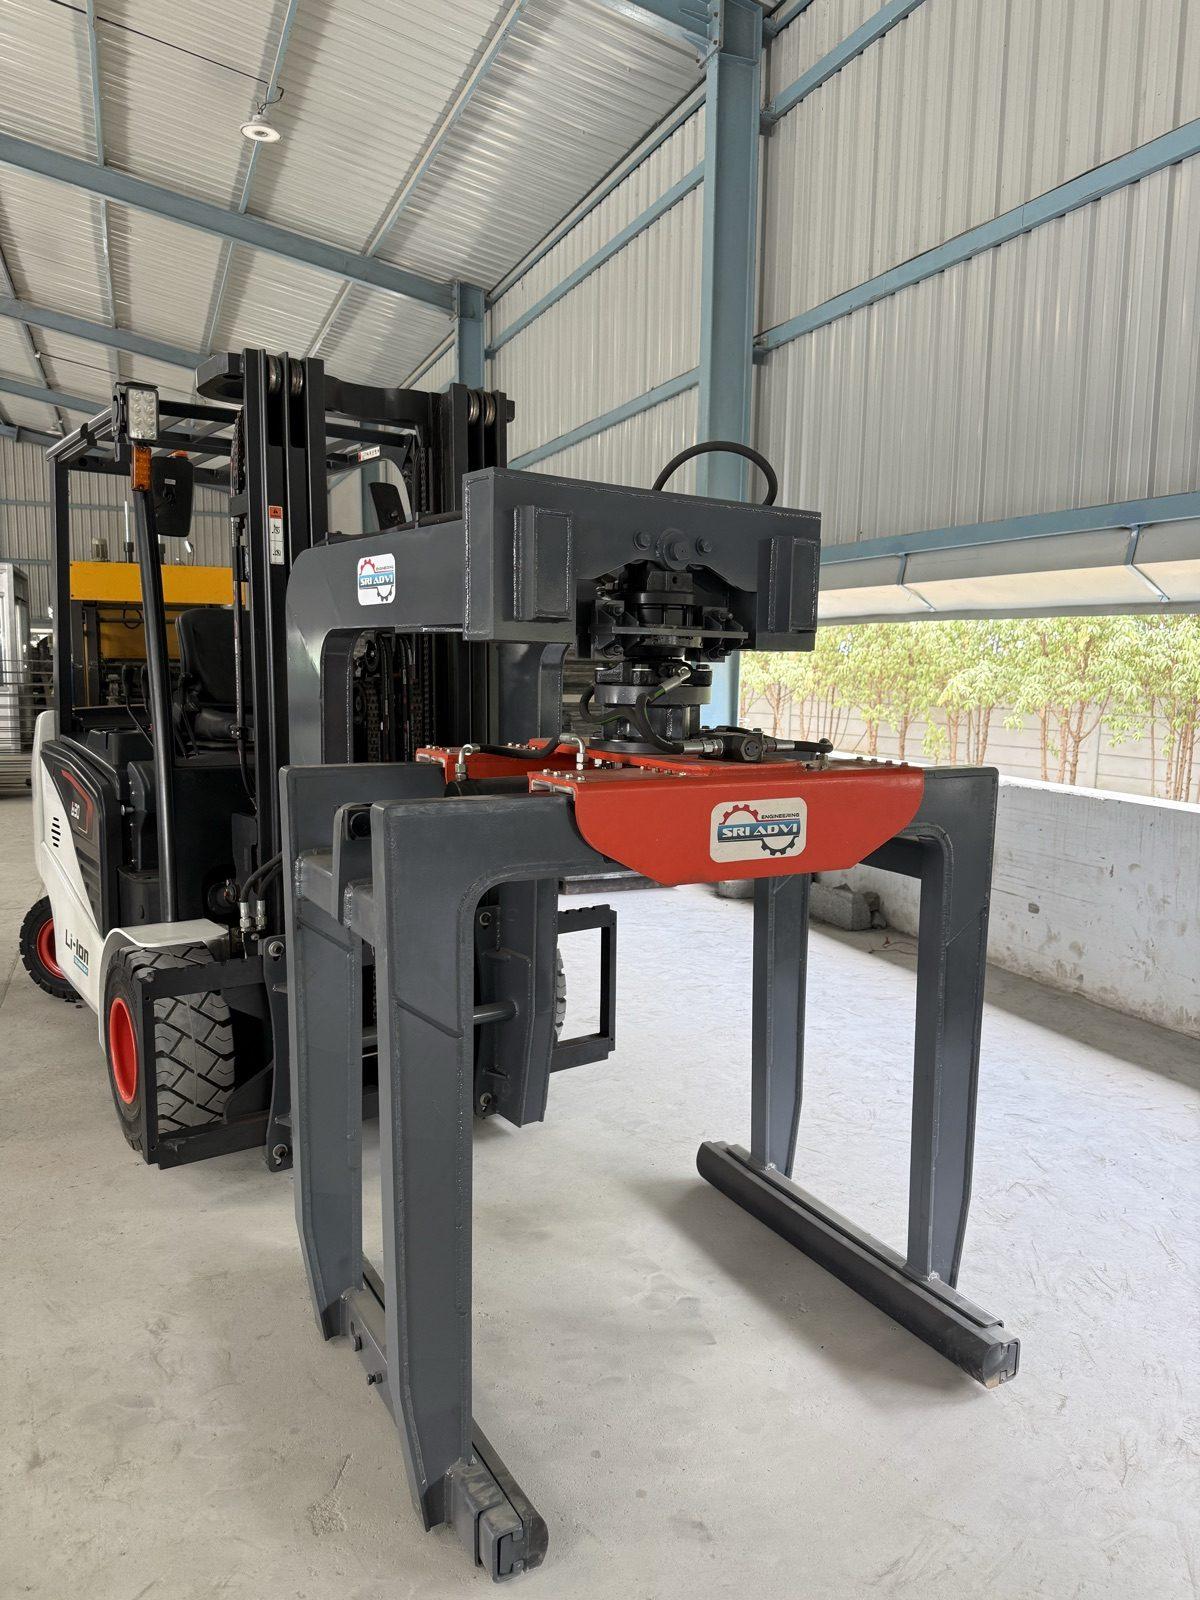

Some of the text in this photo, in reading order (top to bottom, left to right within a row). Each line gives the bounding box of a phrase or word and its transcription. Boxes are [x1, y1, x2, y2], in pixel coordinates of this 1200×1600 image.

[360, 574, 393, 586] SRI ADVI
[761, 812, 800, 820] ENGINEERING
[722, 823, 798, 838] SRI ADVI
